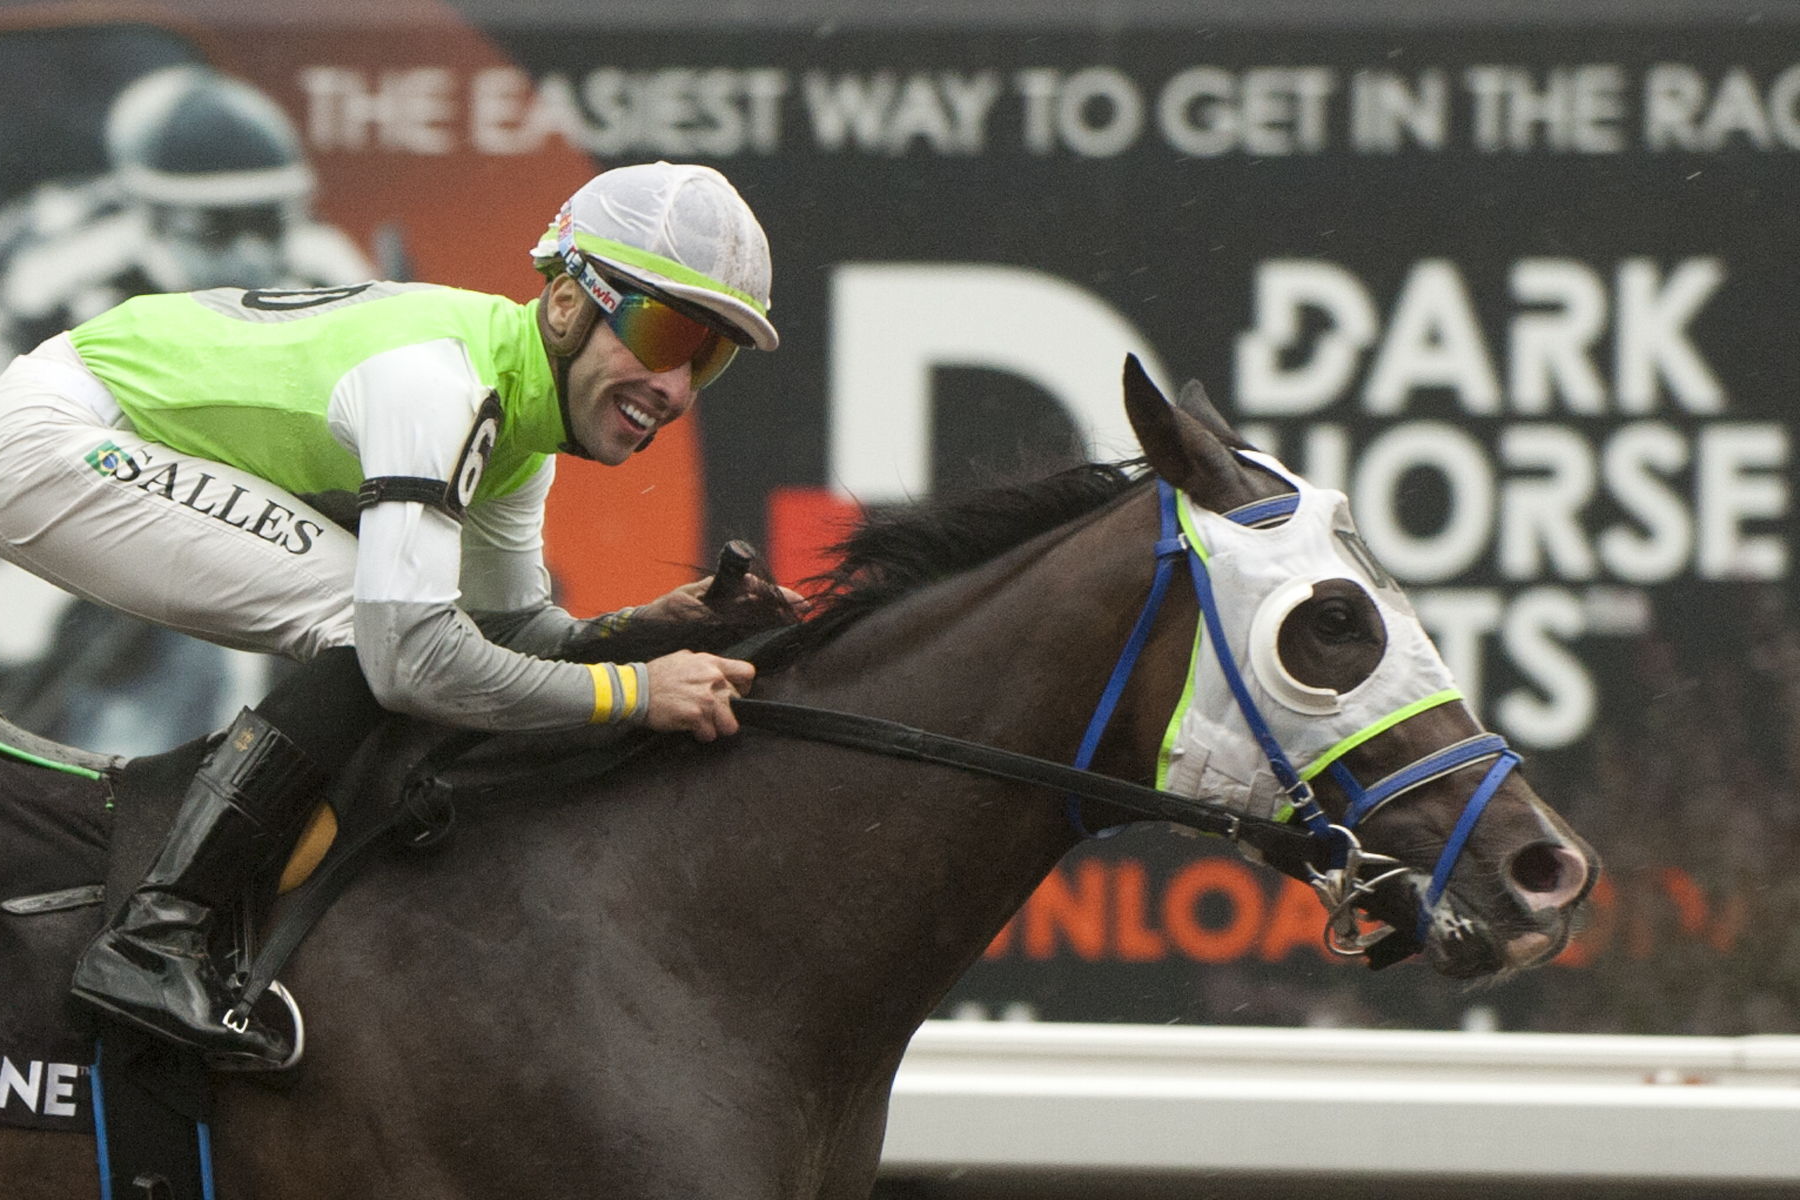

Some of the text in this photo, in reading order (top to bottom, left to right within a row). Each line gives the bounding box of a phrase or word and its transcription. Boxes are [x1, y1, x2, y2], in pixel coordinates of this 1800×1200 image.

[302, 67, 454, 156] THE
[468, 66, 789, 158] EASIEST
[804, 69, 998, 155] WAY
[1014, 66, 1143, 157] TO
[1156, 66, 1336, 157] GET
[1351, 67, 1448, 154] IN
[1463, 65, 1626, 154] THE
[1234, 257, 1726, 416] DARK
[112, 447, 325, 556] SALLES
[457, 415, 498, 509] 6
